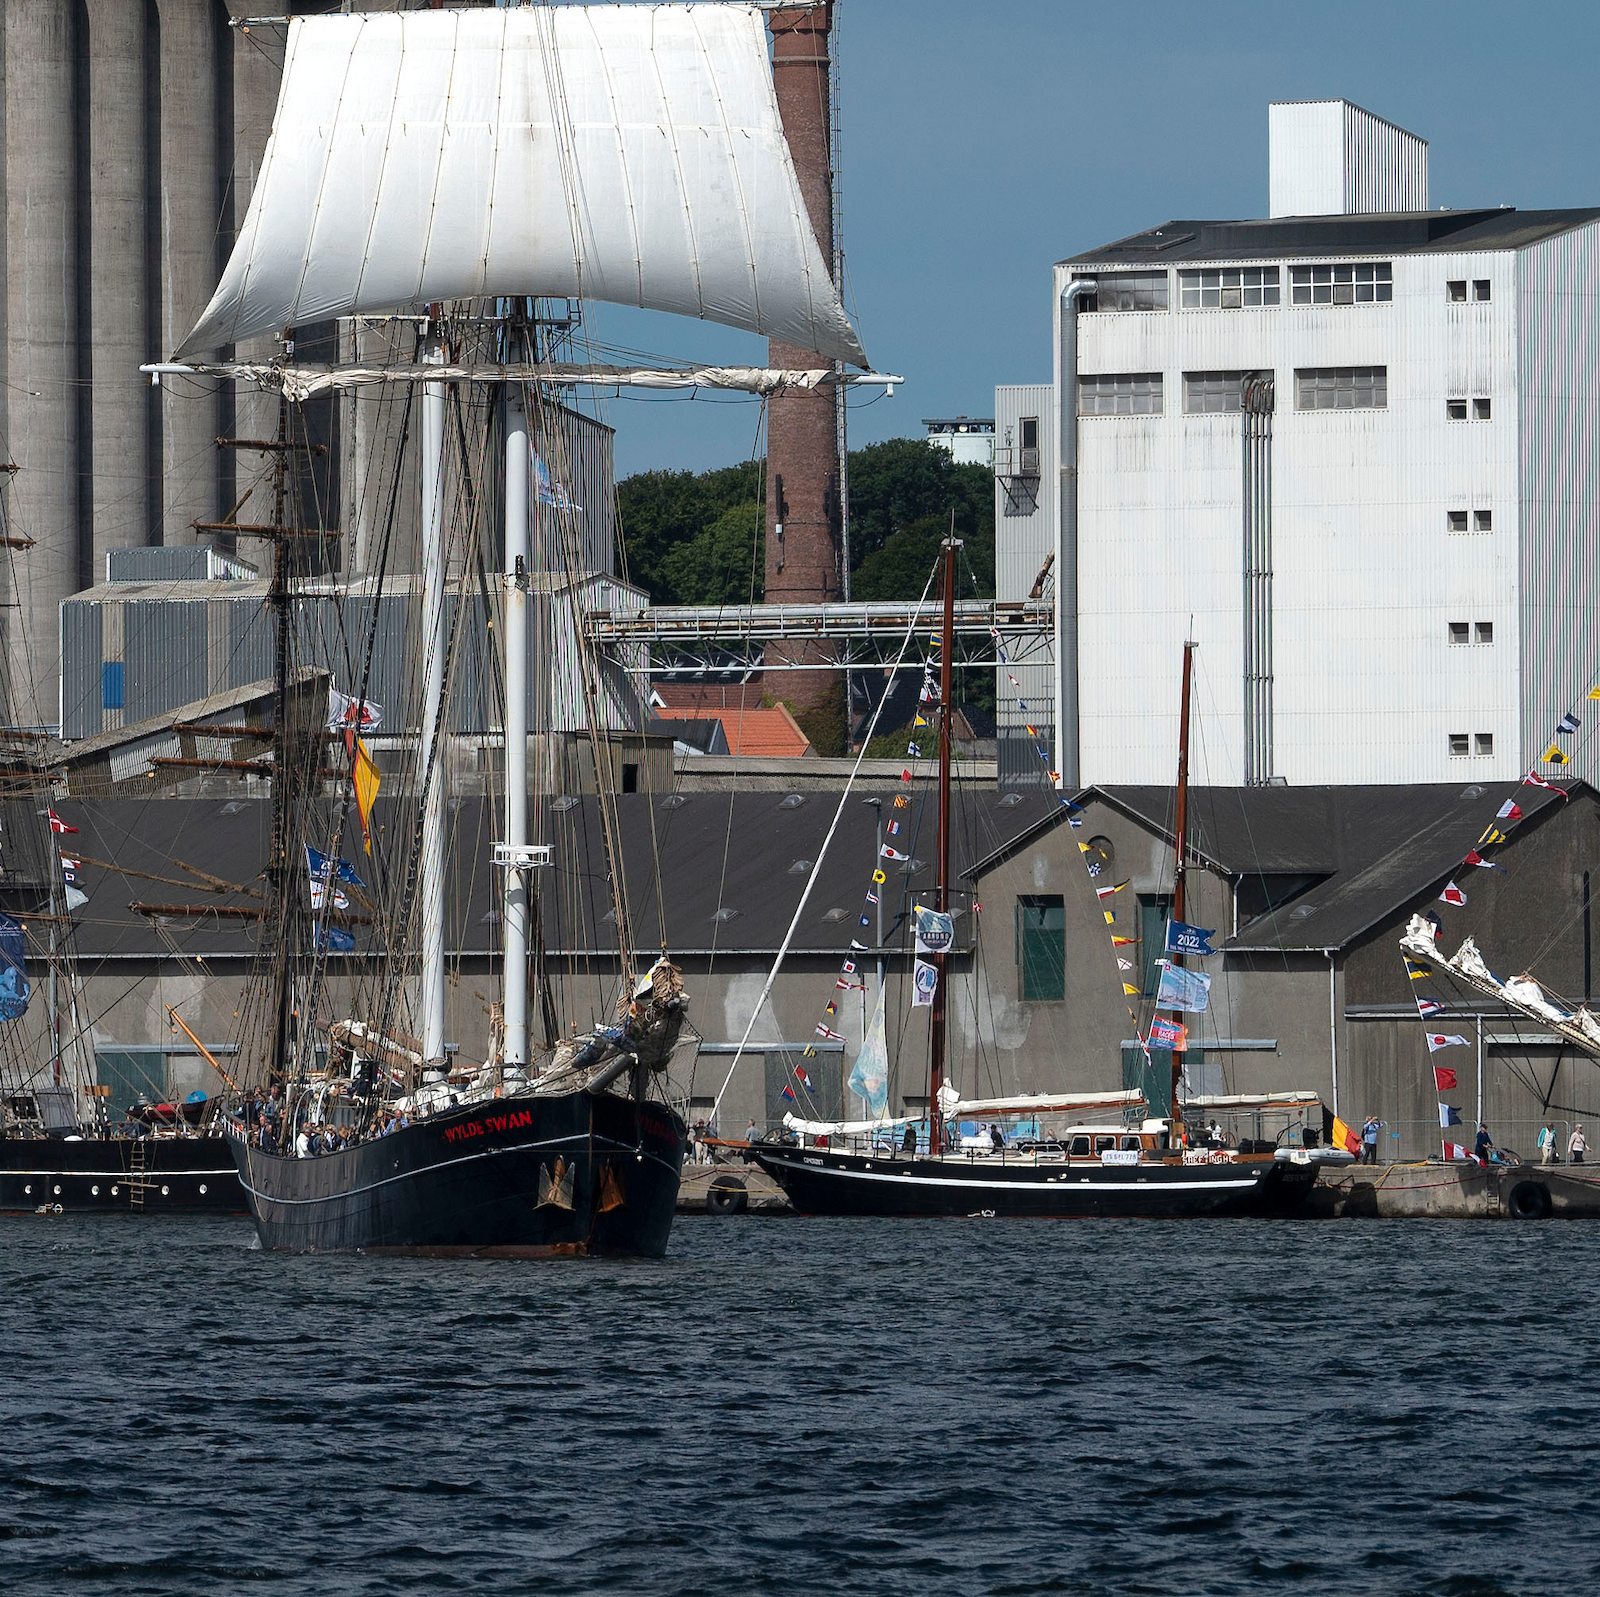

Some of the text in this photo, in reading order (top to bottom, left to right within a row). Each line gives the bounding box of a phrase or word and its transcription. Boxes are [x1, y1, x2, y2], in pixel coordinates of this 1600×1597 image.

[1177, 934, 1200, 948] 2022
[444, 1110, 532, 1143] WYLDE SWAN
